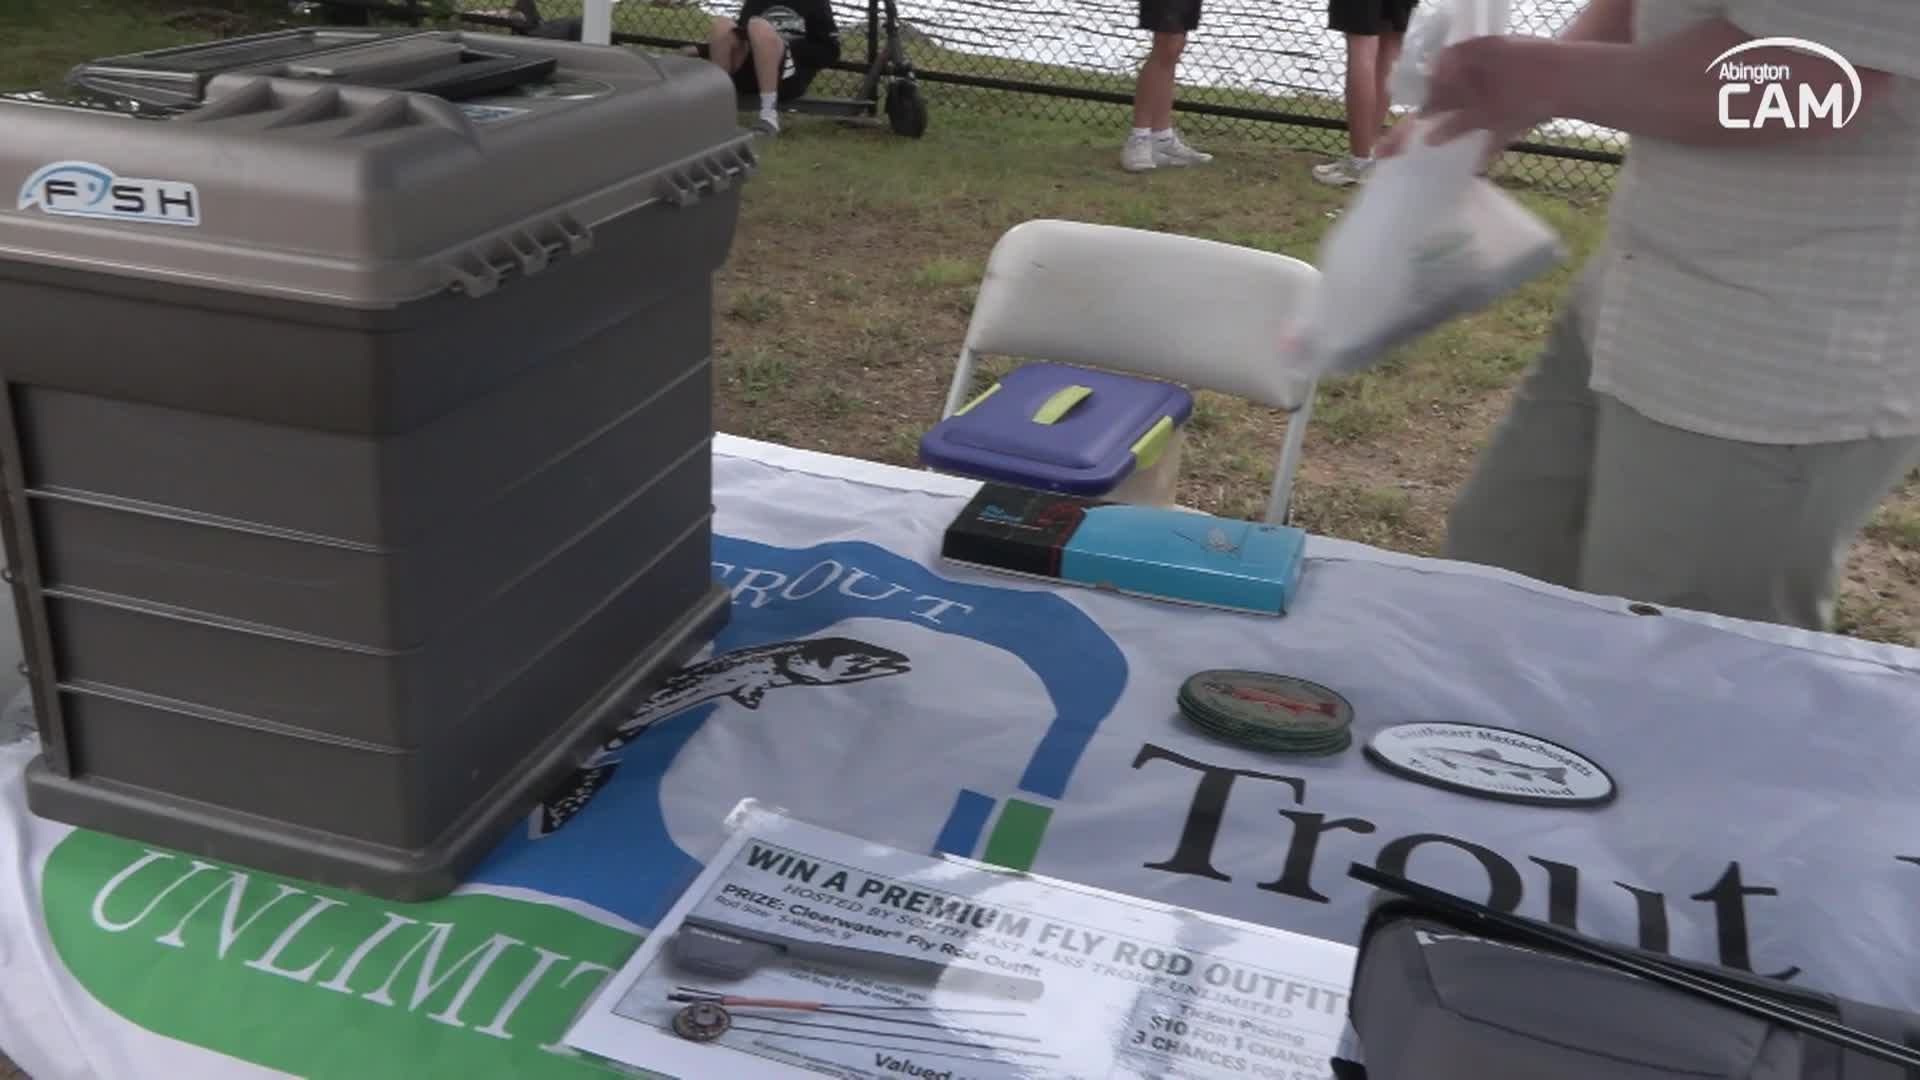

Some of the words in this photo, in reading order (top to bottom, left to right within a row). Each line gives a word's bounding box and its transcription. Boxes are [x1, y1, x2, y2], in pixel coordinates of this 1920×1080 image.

[1131, 743, 1801, 981] Trout
[782, 883, 865, 914] HOSTED
[867, 907, 893, 921] BY
[722, 883, 785, 911] PRIZE:
[905, 934, 938, 951] Fly
[939, 942, 979, 961] Rod
[983, 954, 1042, 977] Outfit
[748, 846, 820, 883] WIN
[820, 870, 849, 894] A
[857, 879, 1031, 938] PREMIUM
[1038, 922, 1105, 957] FLY
[1112, 941, 1194, 978] ROD
[1202, 962, 1349, 1016] OUTFIT
[1132, 1030, 1146, 1045] 3
[1150, 1035, 1247, 1072] CHANCES
[1150, 1014, 1188, 1036] $10
[1191, 1028, 1228, 1046] FOR
[1233, 1036, 1244, 1050] 1
[874, 1052, 952, 1080] Valued
